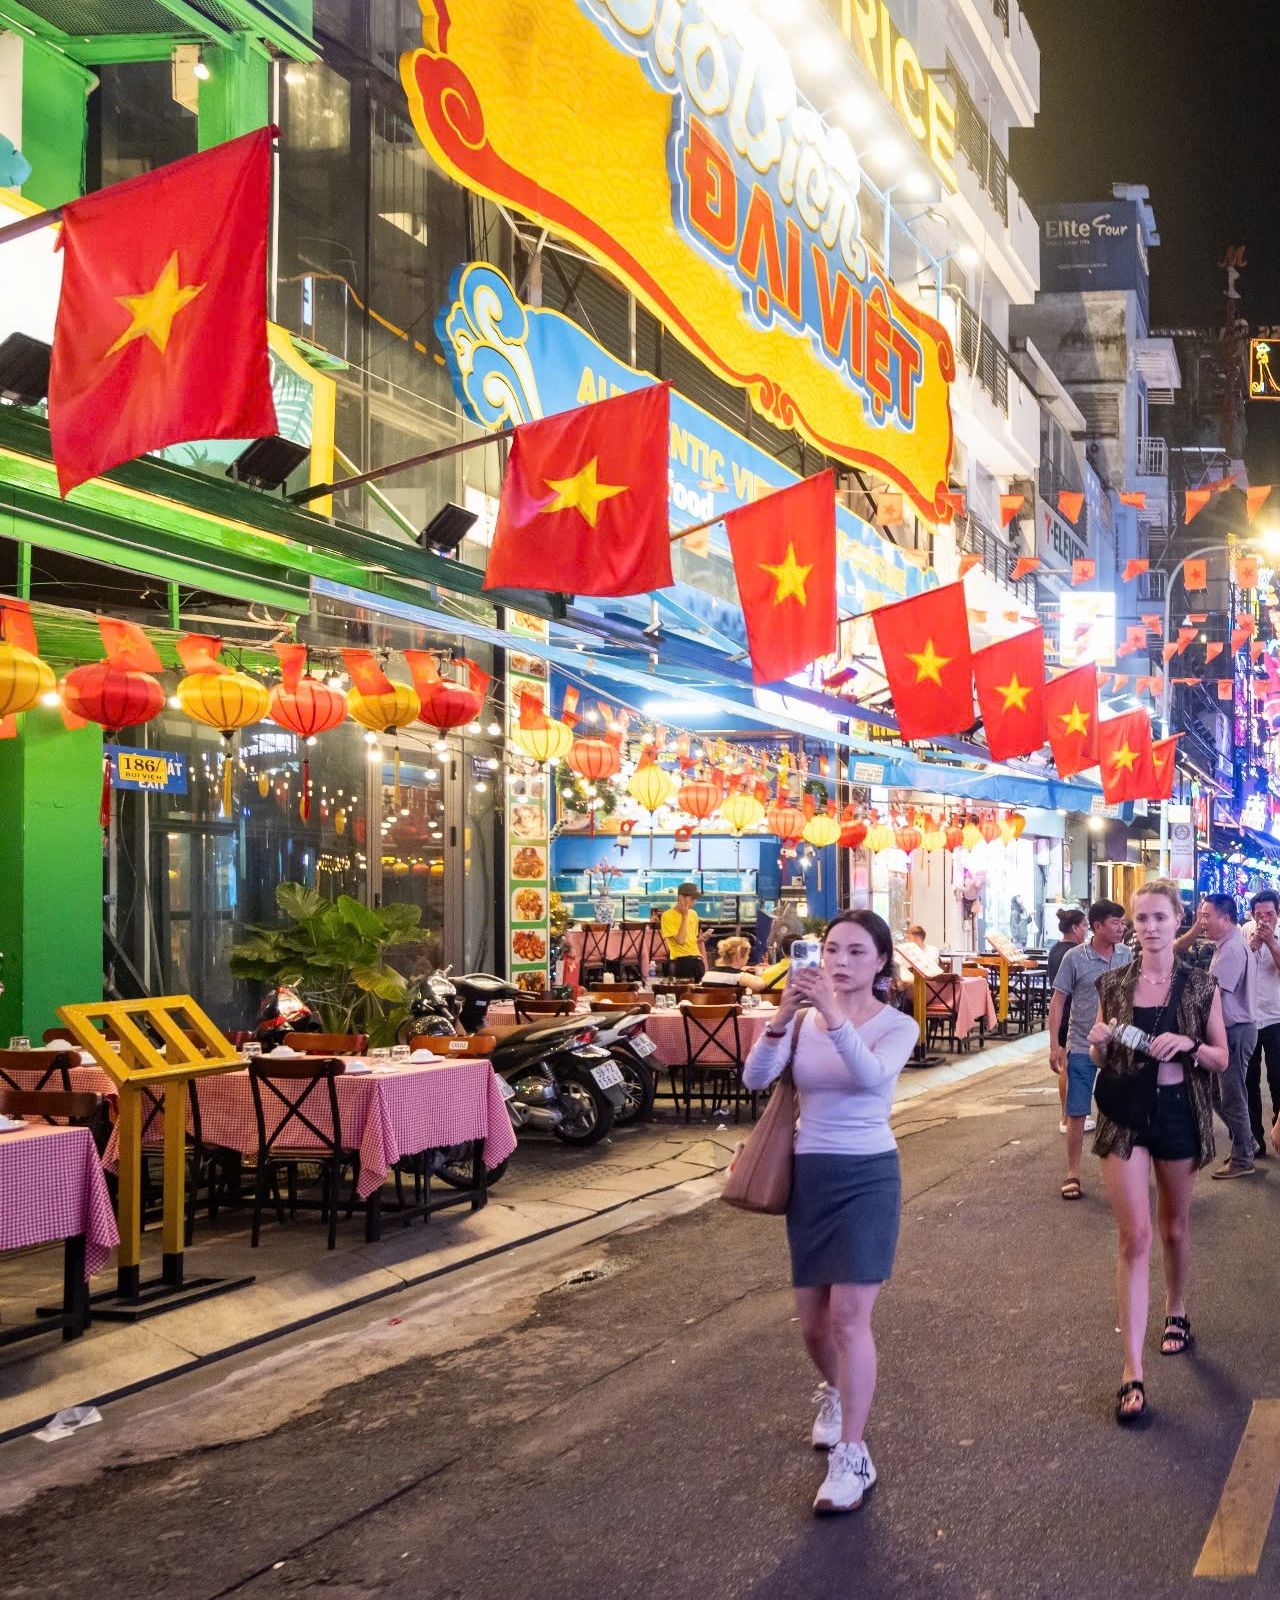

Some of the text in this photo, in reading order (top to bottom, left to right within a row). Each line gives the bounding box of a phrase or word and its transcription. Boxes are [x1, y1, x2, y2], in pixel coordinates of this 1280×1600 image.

[840, 0, 958, 194] RICE
[684, 113, 922, 424] ĐẠI VIỆT
[1045, 219, 1091, 238] Elite
